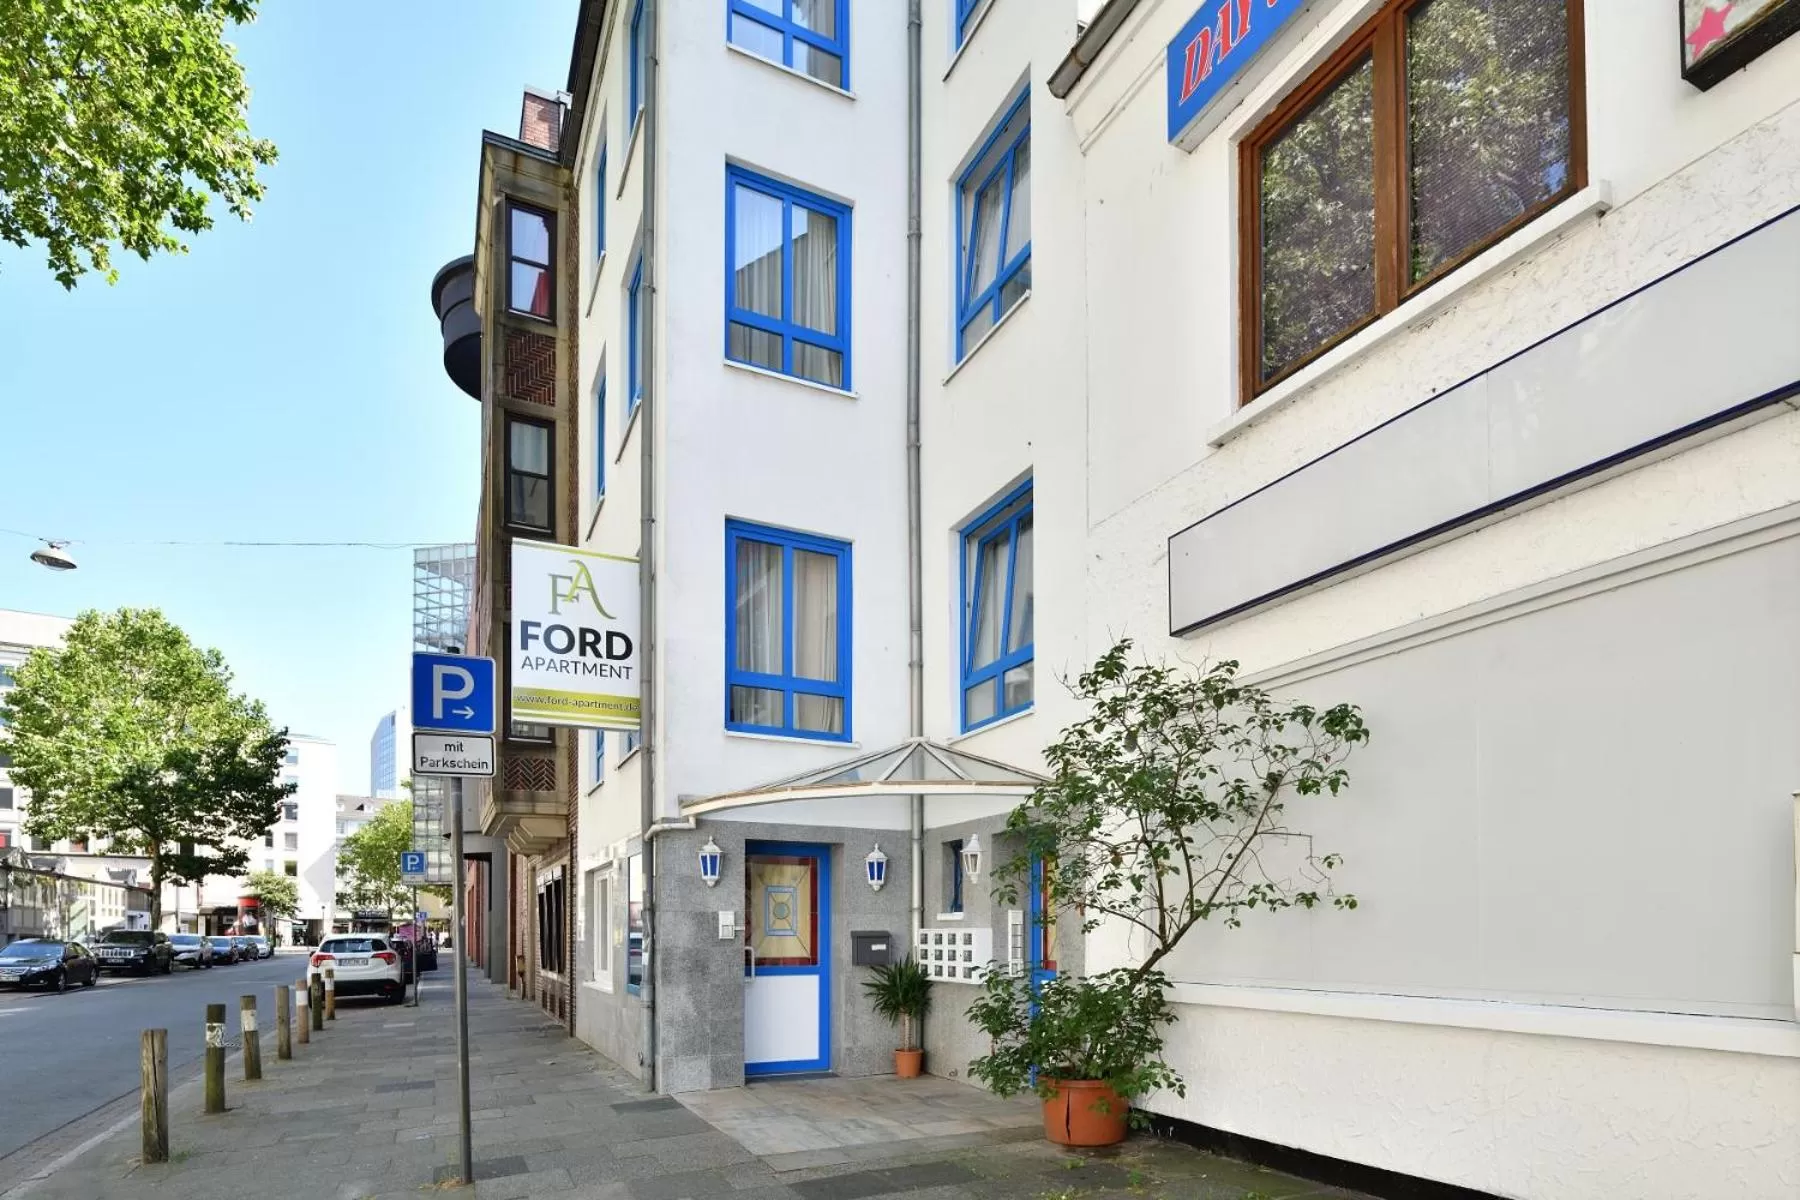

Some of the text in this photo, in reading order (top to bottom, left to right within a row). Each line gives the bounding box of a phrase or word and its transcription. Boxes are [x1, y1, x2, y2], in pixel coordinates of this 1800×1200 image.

[520, 619, 633, 661] FORD
[521, 655, 633, 680] APARTMENT
[432, 664, 475, 720] P
[516, 695, 640, 713] www.ford-apartment.de
[444, 741, 464, 753] mit
[420, 756, 489, 770] Parkschein
[407, 854, 420, 871] P
